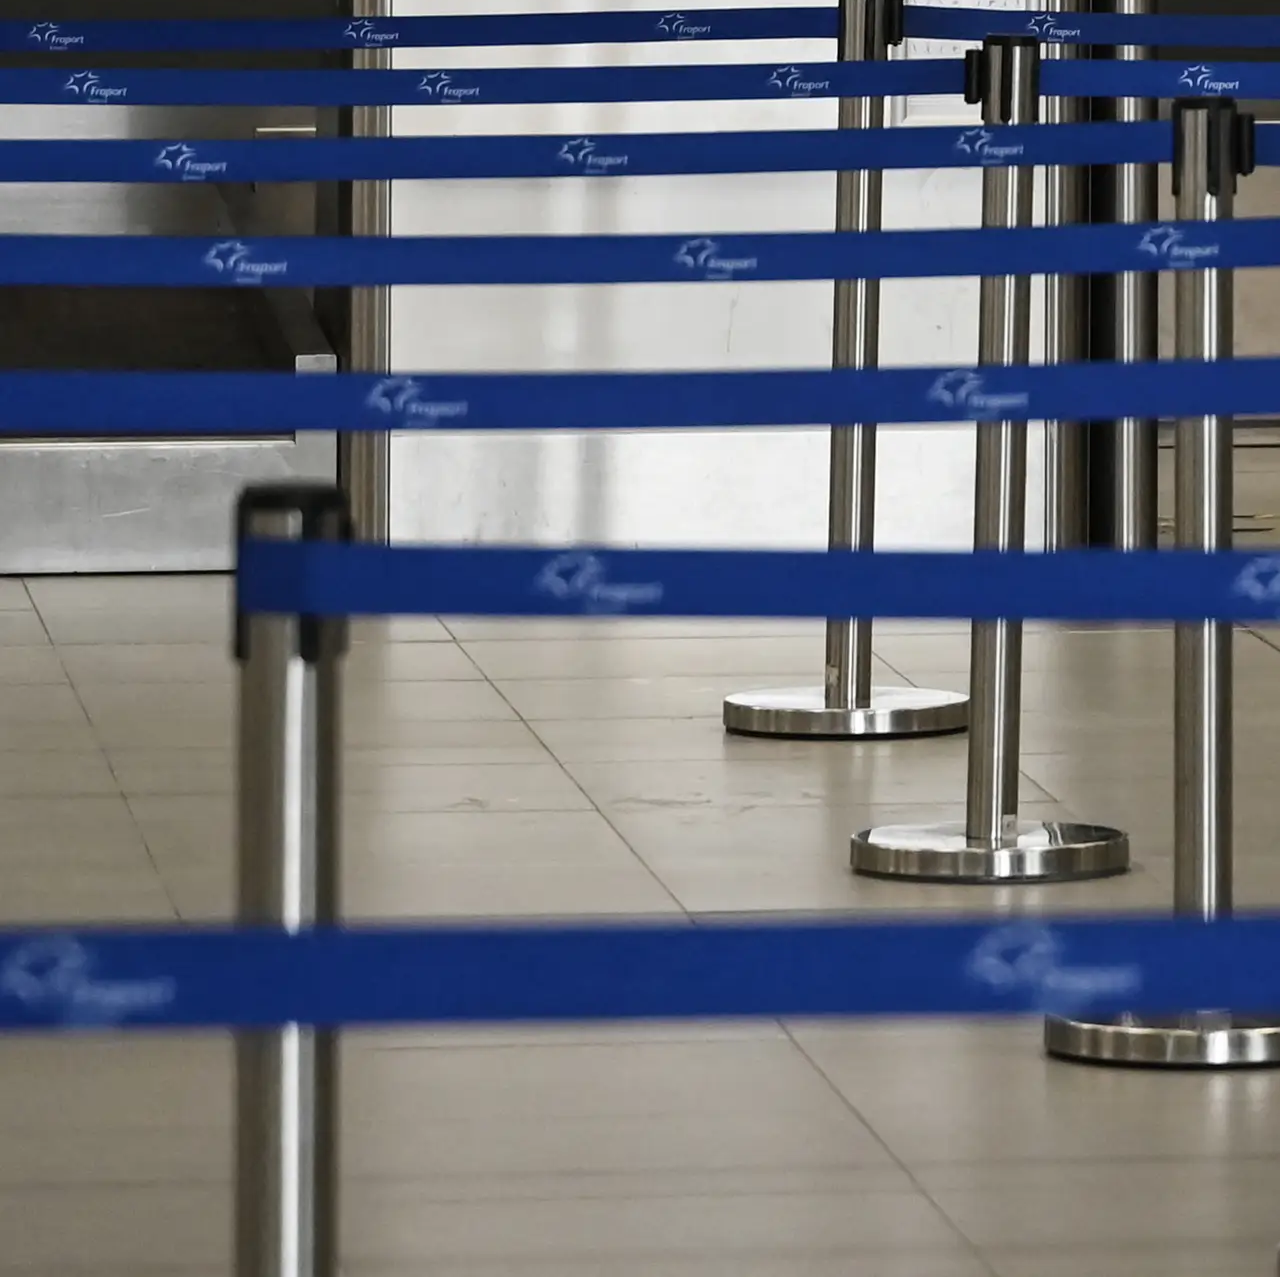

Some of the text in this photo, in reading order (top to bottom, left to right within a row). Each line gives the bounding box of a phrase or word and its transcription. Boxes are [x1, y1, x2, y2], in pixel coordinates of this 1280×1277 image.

[679, 25, 710, 35] Fraport
[1049, 28, 1080, 39] Fraport
[52, 35, 84, 46] Fraport
[368, 31, 399, 42] Fraport
[794, 80, 830, 91] Fraport
[1204, 79, 1239, 91] Fraport
[90, 86, 127, 98] Fraport
[444, 86, 479, 98] Fraport
